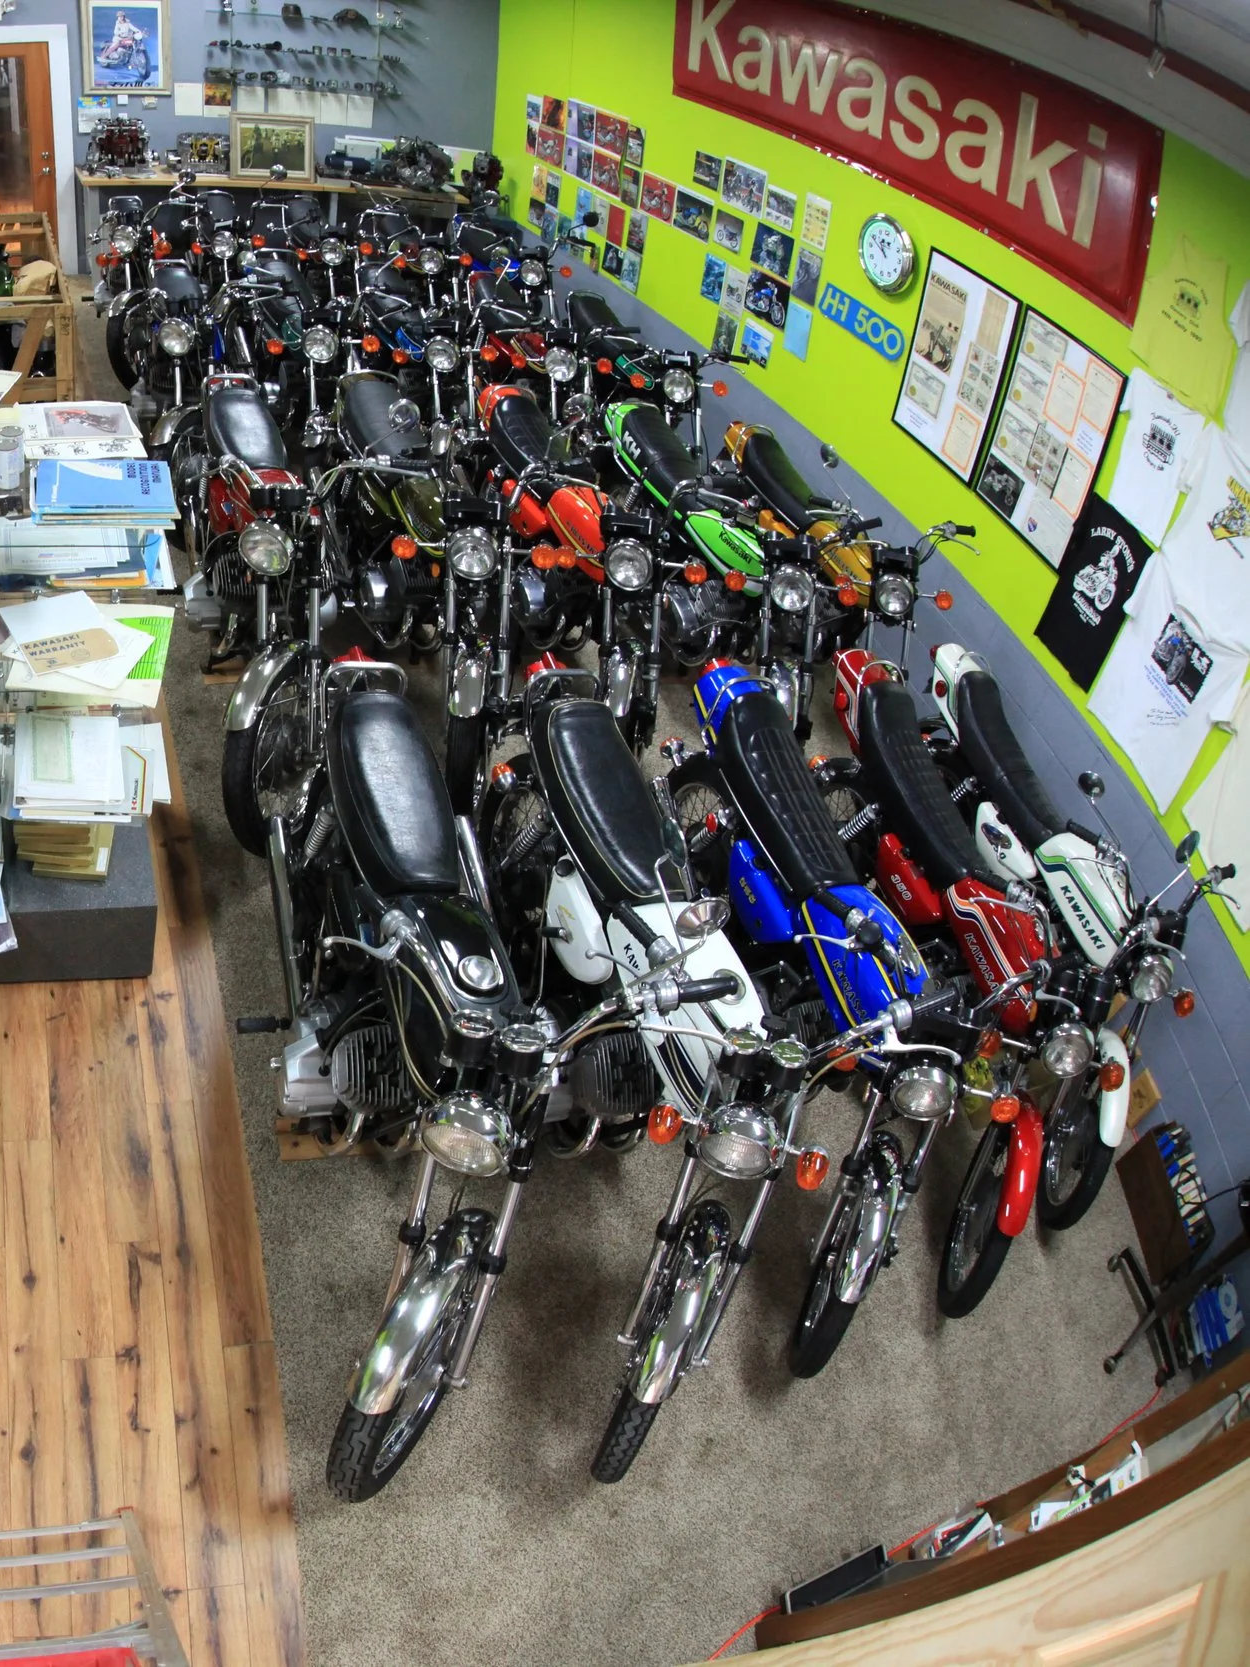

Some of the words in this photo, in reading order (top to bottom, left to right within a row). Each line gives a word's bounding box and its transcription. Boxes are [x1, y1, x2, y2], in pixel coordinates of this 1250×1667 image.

[688, 0, 1107, 250] Kawasaki
[931, 274, 967, 302] KAWASAKI
[854, 307, 902, 355] 500
[623, 430, 641, 460] KH
[127, 463, 136, 478] MODEL
[139, 463, 150, 495] RECOGNITION
[151, 463, 161, 483] MANUAL
[718, 530, 753, 564] Kawasaki
[1091, 527, 1116, 540] LARRY
[24, 634, 80, 650] KAWASAKI
[29, 641, 86, 657] WARRANTY
[891, 874, 912, 900] 350
[1060, 885, 1106, 950] KAWASAKI
[964, 932, 1000, 991] KAWASA
[833, 959, 871, 1024] KAWASA
